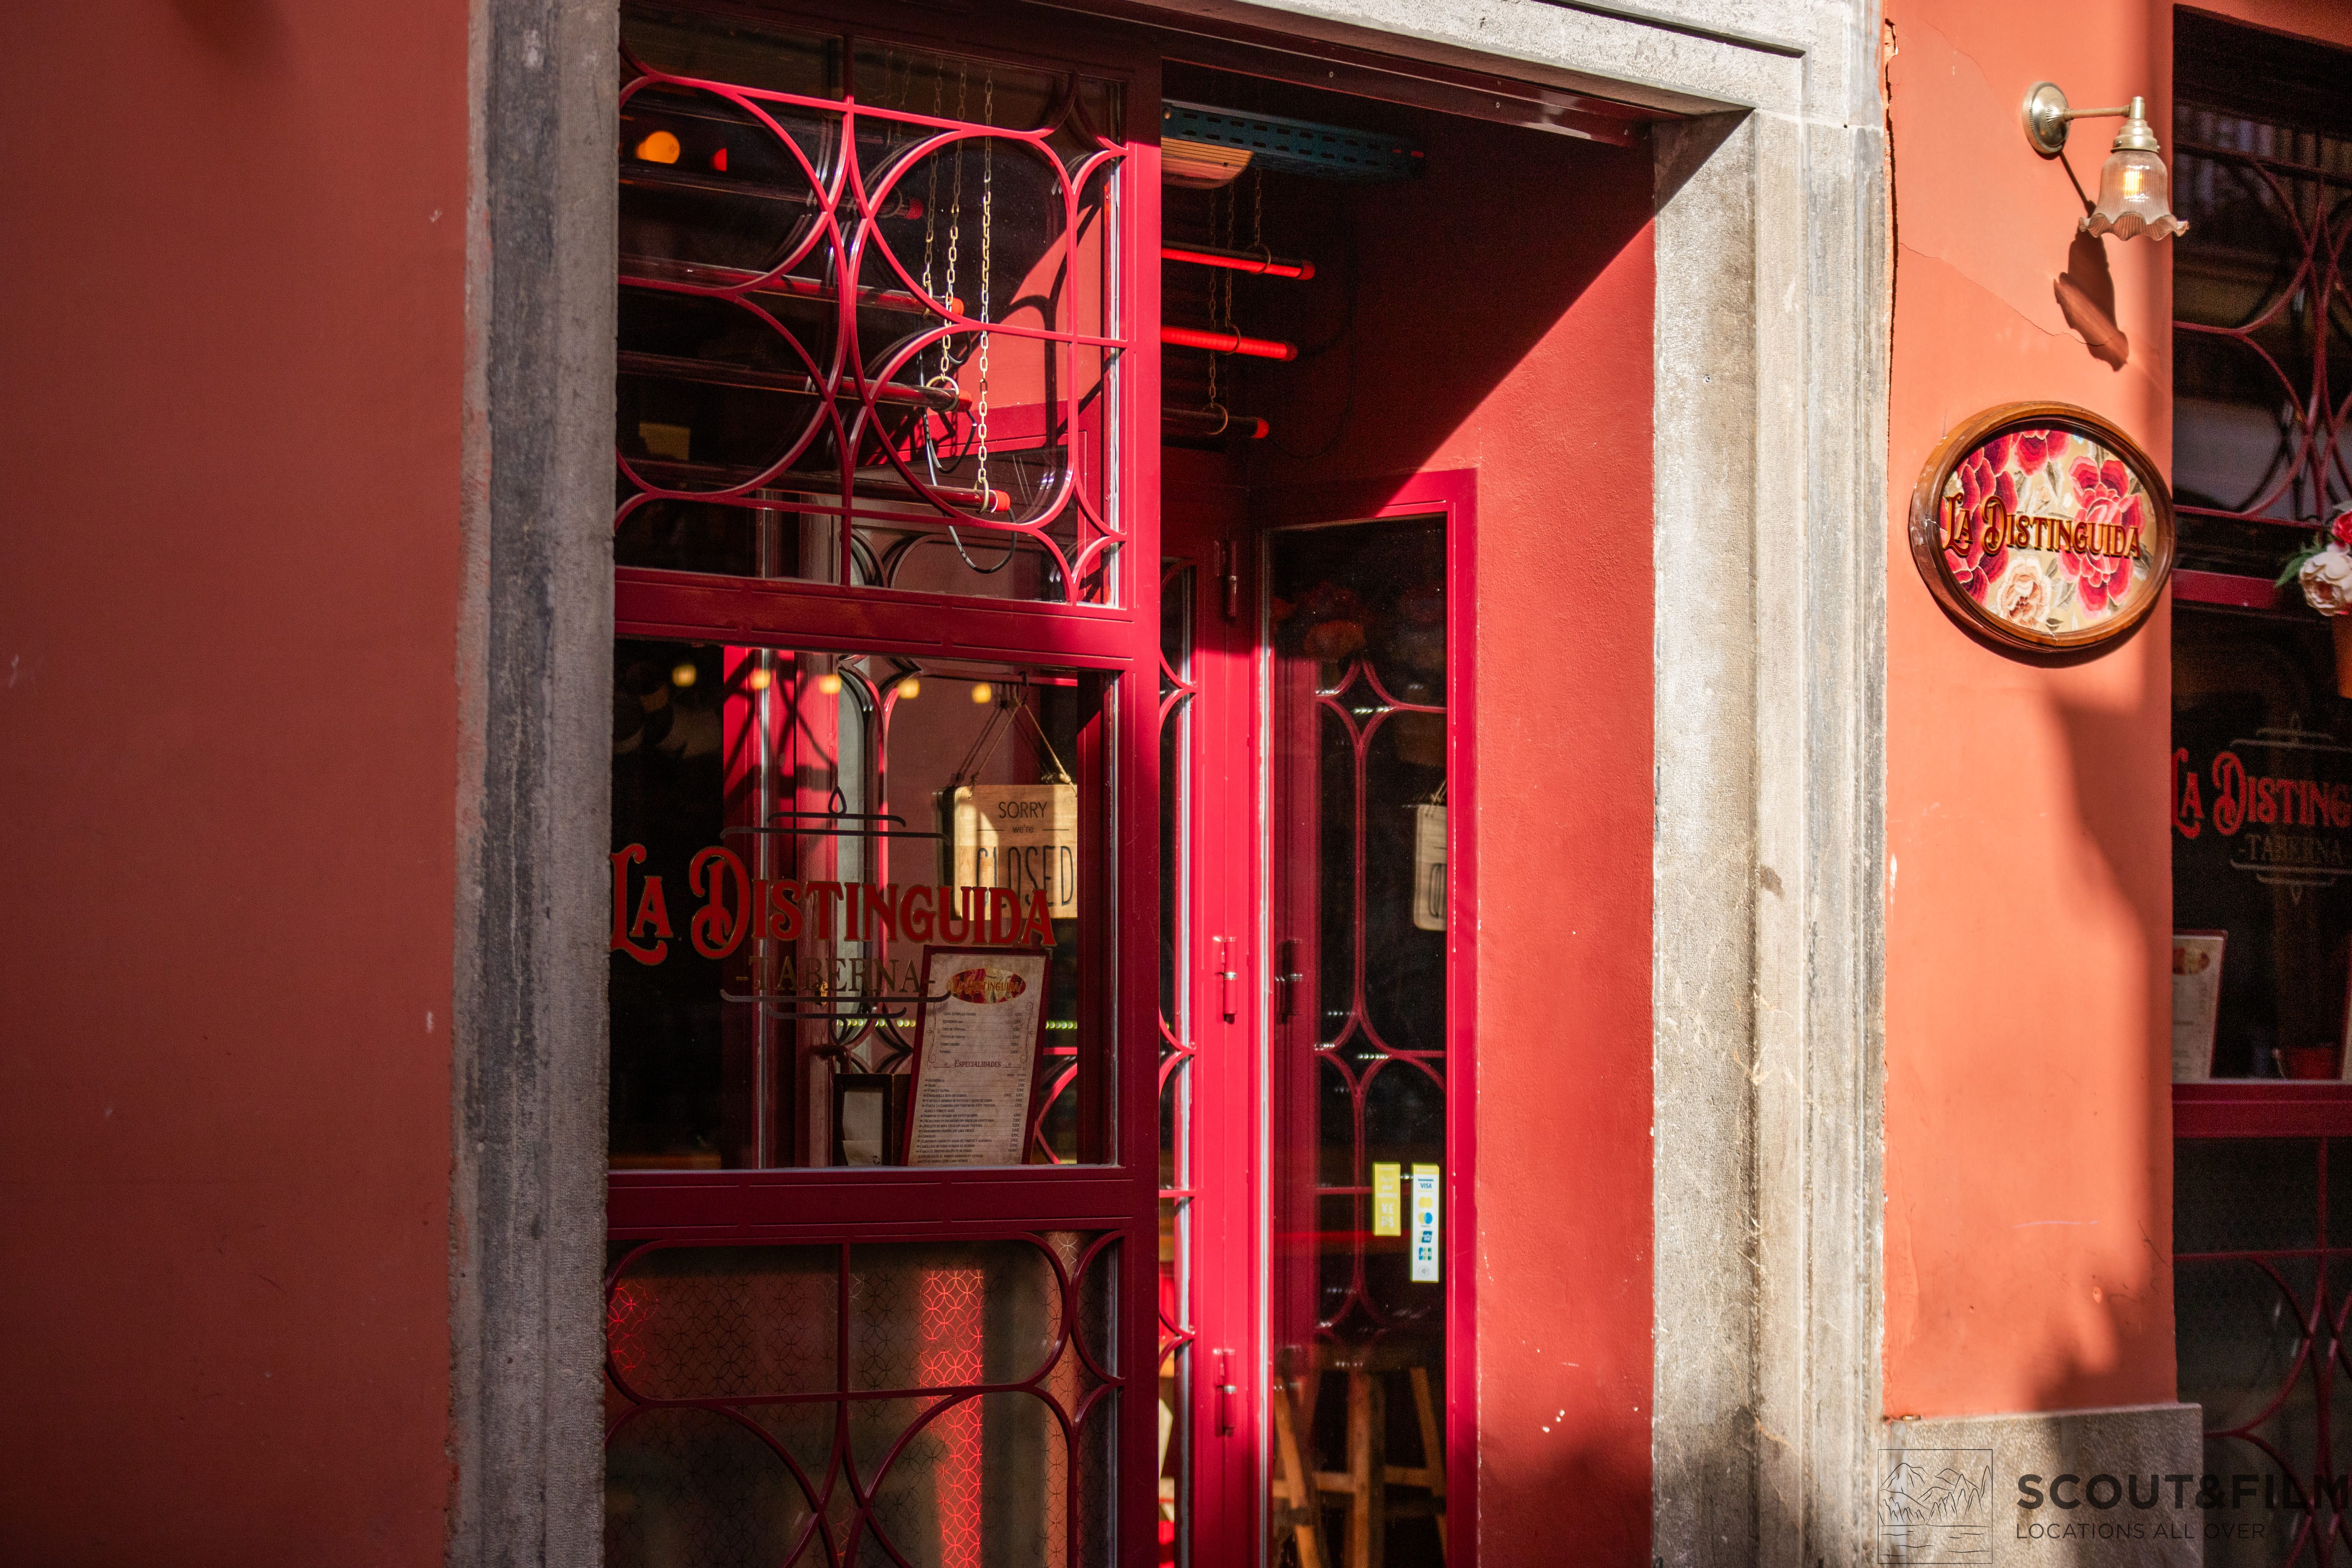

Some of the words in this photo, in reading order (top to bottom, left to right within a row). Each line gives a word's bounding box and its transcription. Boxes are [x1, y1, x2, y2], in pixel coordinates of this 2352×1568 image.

[1943, 492, 1974, 557] LA
[1981, 495, 2141, 558] DISTINGUIDA
[999, 801, 1047, 818] SORRY
[609, 843, 674, 966] LA
[690, 846, 1058, 959] DISTINGUIDA
[964, 977, 1019, 994] DISTINGUIDA
[954, 1060, 1001, 1068] ESPECIALIDADES
